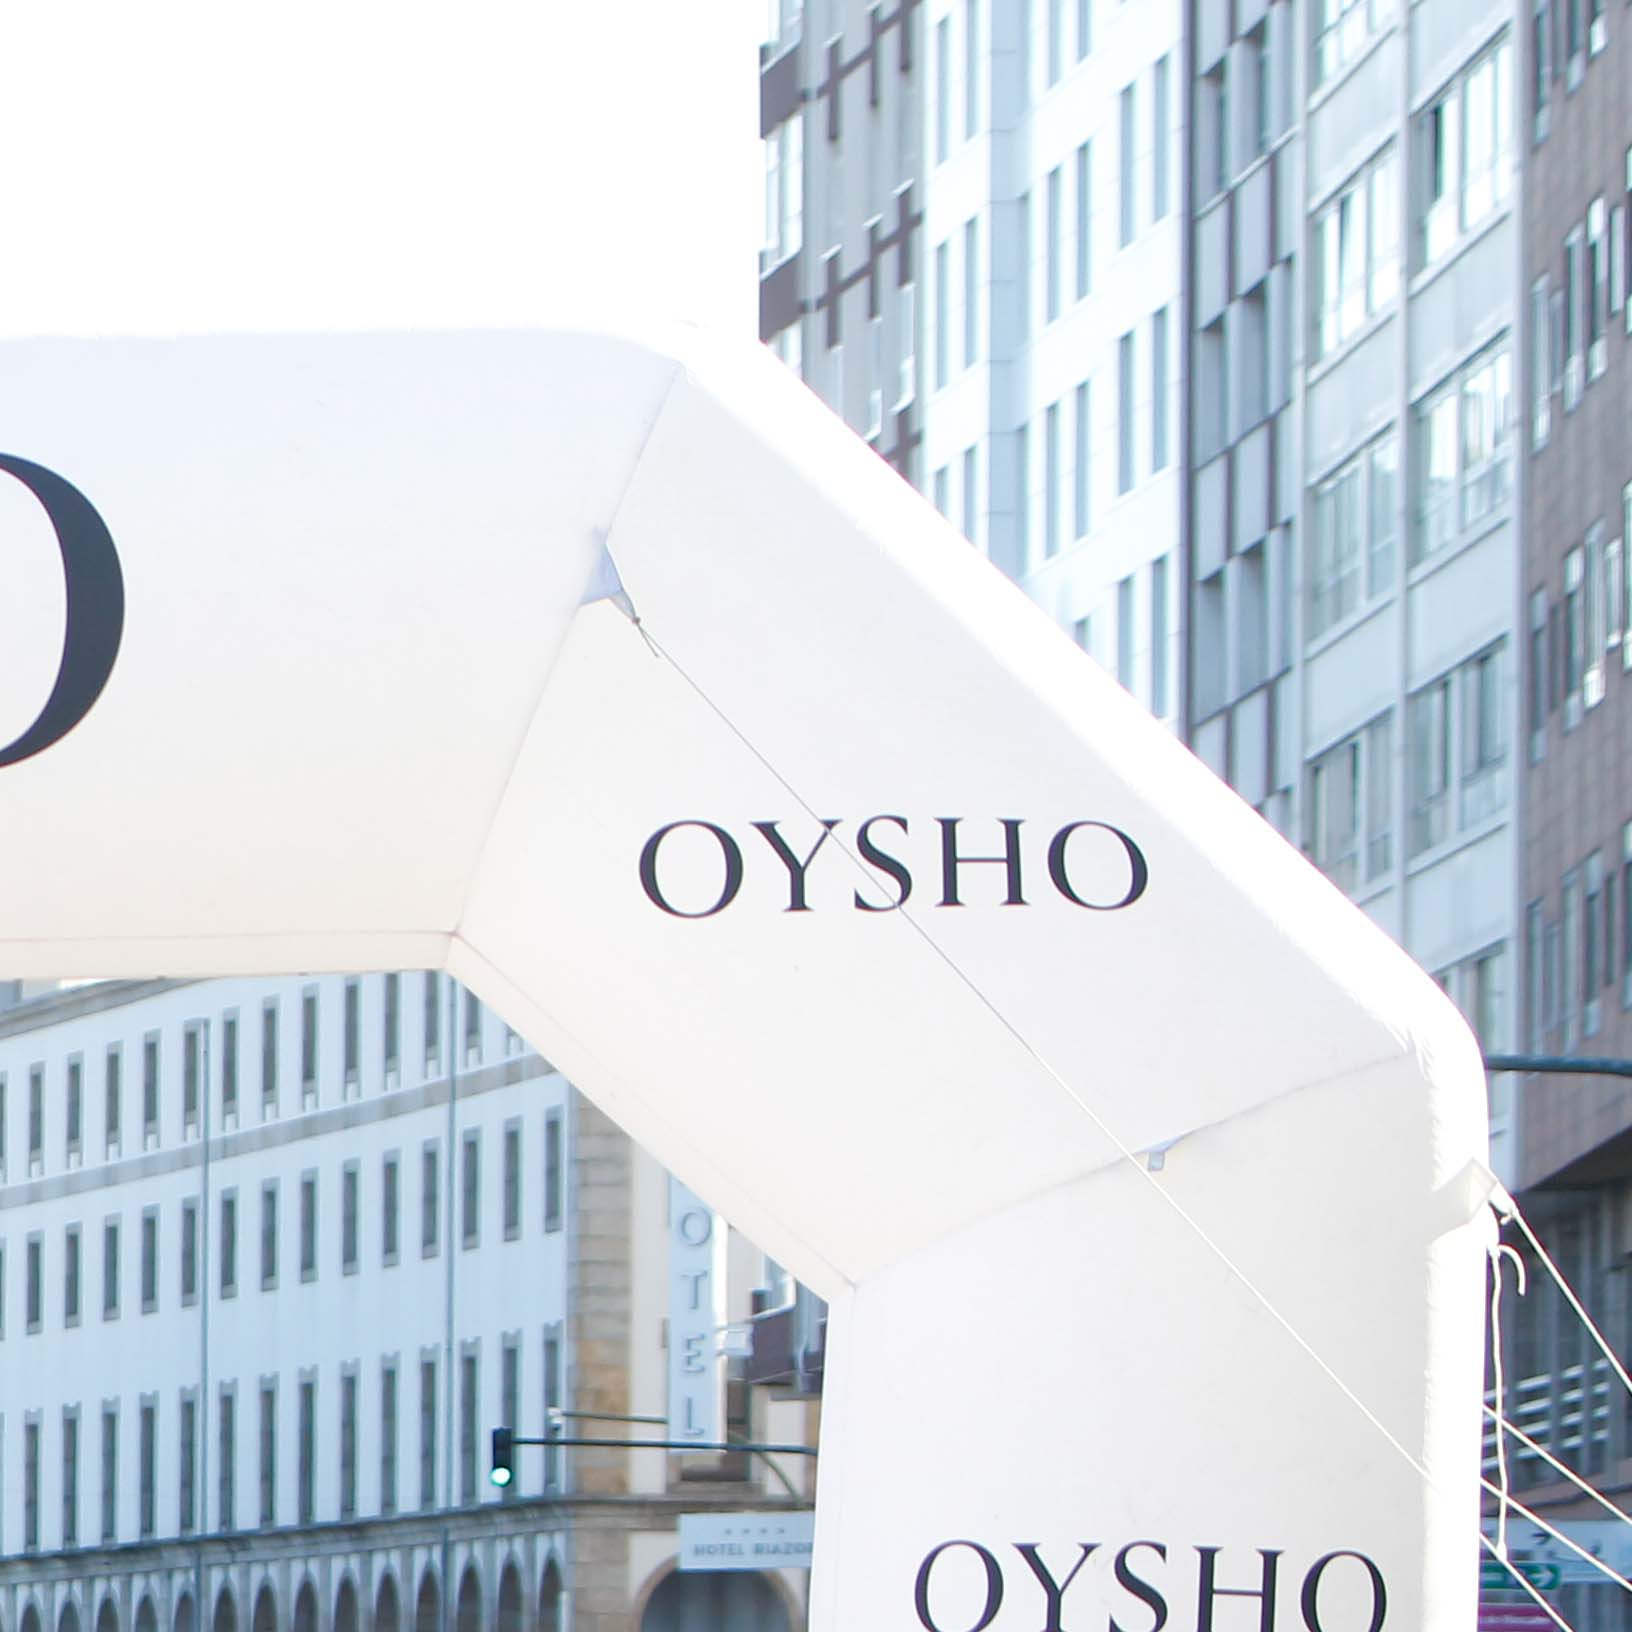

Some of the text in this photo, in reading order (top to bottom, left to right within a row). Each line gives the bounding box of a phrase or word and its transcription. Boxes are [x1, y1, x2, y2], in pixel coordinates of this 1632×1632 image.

[640, 816, 1147, 919] OYSHO
[680, 1205, 712, 1437] OTEL
[693, 1542, 745, 1556] HOTEL
